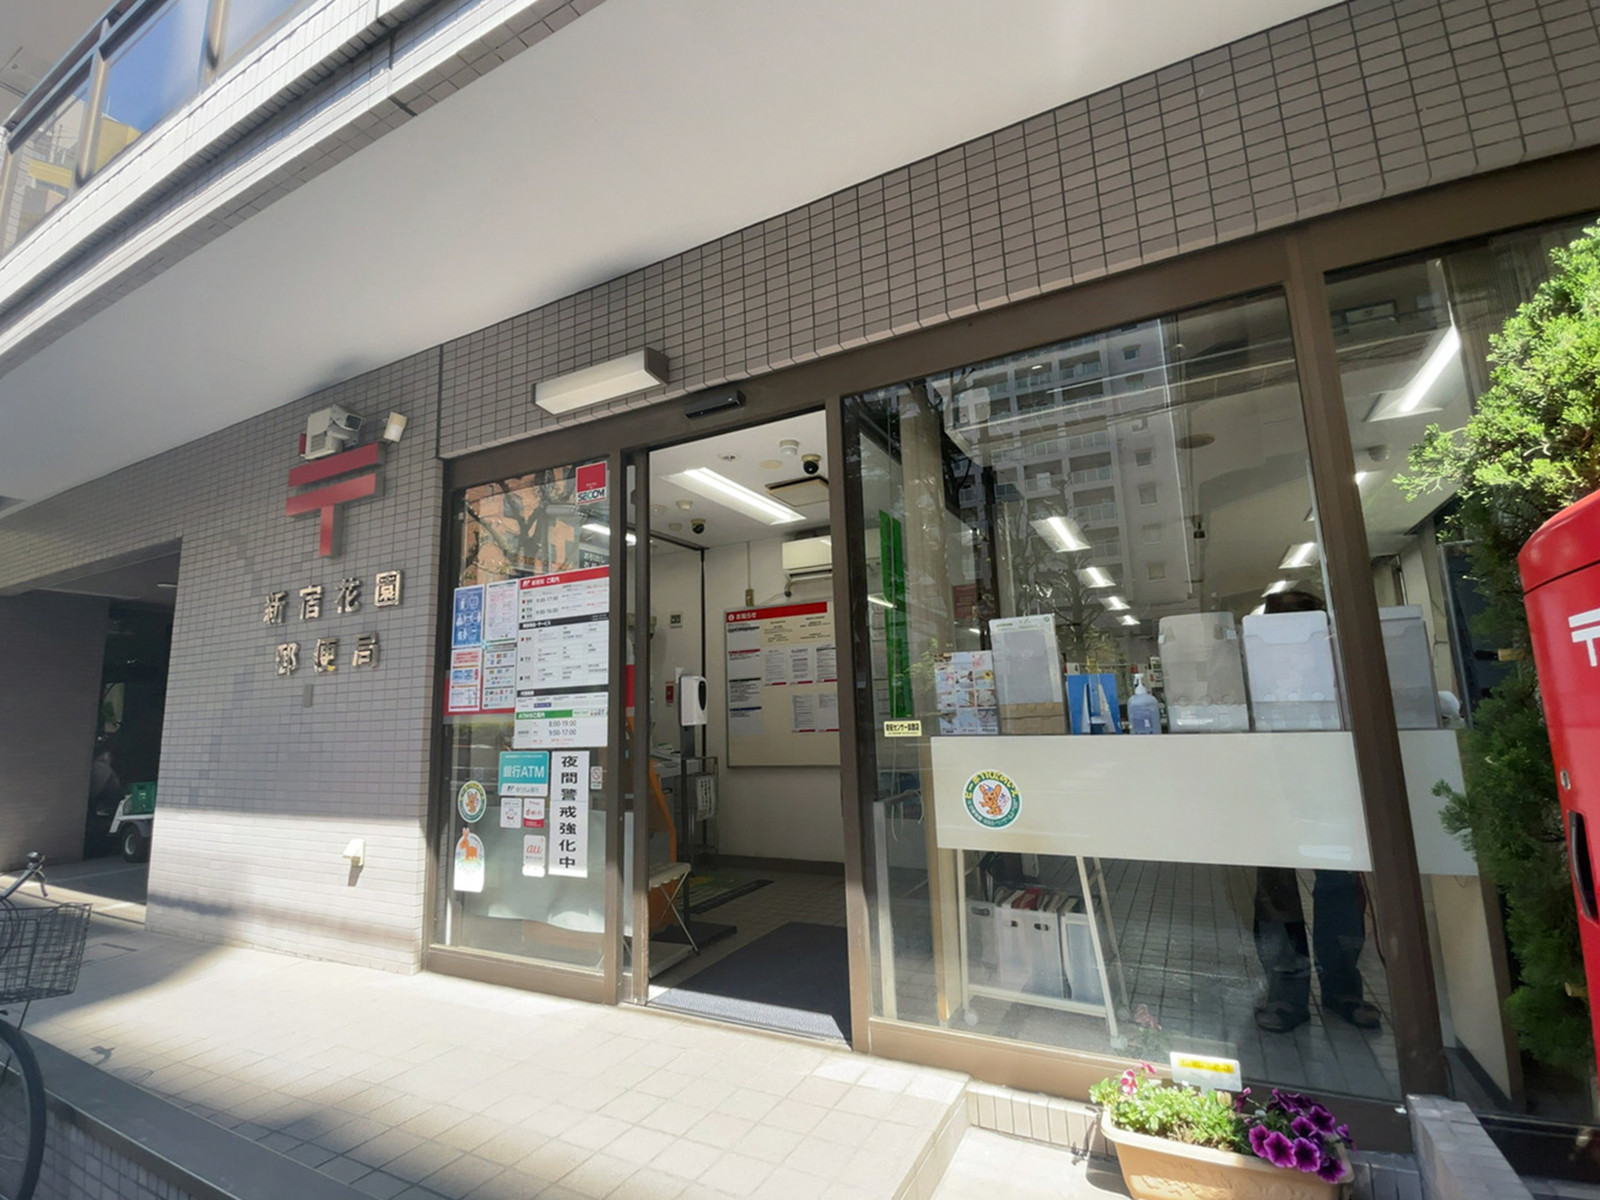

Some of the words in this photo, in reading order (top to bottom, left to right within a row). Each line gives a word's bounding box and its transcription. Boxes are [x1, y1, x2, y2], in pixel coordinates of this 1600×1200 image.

[578, 489, 606, 501] SECOM
[263, 570, 401, 624] 新宿花園
[276, 632, 379, 676] 郵便局
[503, 765, 545, 778] 銀行ATM
[558, 755, 579, 869] 夜間警戒強化中
[526, 844, 542, 854] au
